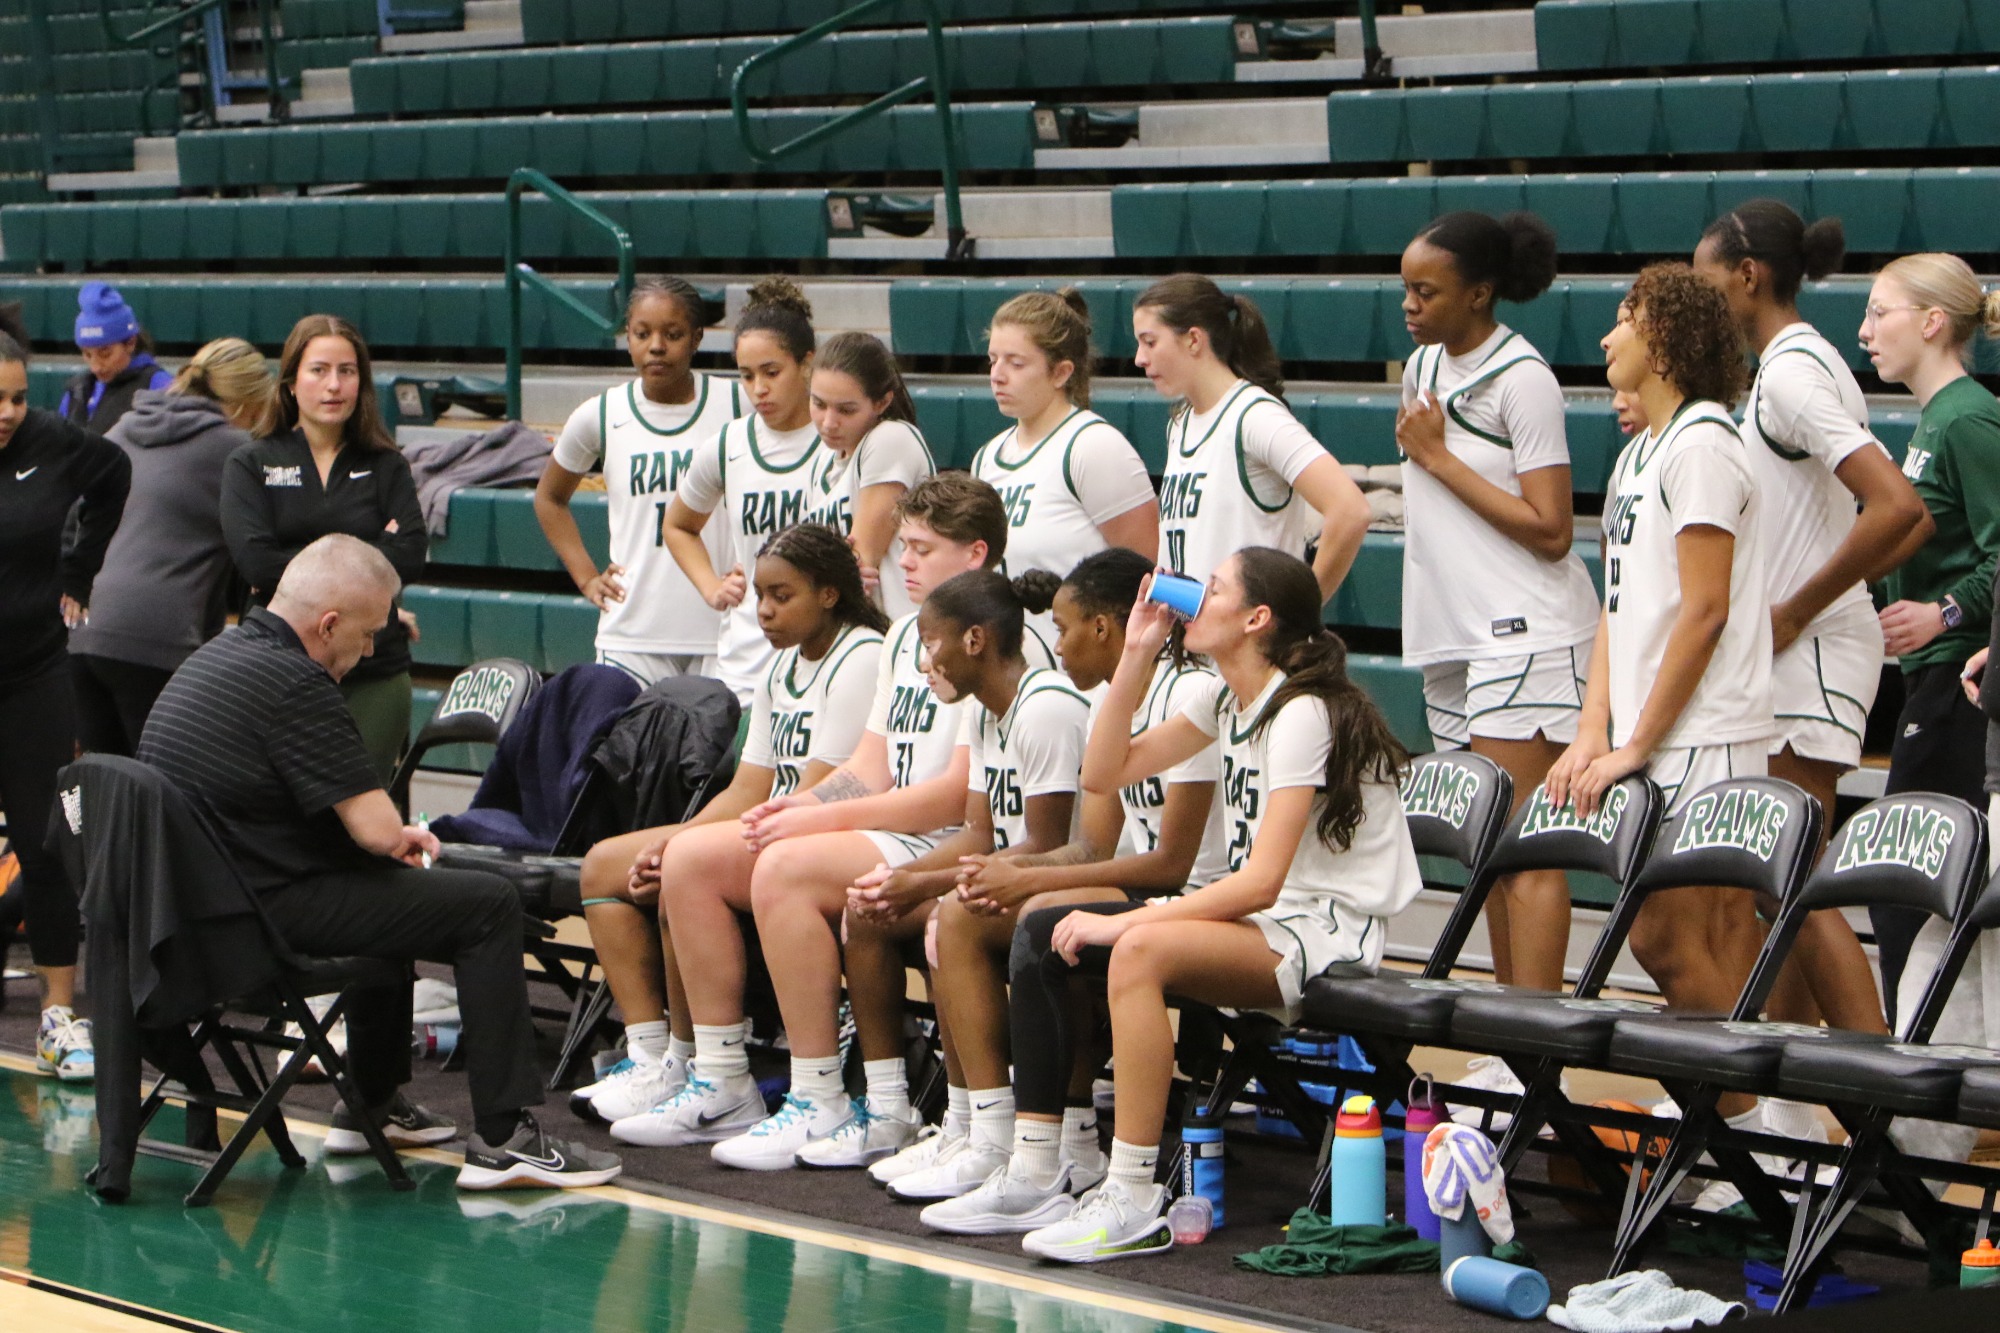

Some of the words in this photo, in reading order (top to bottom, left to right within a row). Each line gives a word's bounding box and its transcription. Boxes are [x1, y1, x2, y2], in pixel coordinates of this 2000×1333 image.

[630, 448, 694, 497] RAM
[742, 489, 808, 536] RAM
[997, 483, 1036, 528] MS
[1608, 494, 1644, 546] AMS
[1513, 620, 1525, 630] XL
[439, 667, 516, 723] RAMS
[1672, 788, 1789, 862] RAMS
[1834, 803, 1956, 880] RAMS
[1182, 1142, 1192, 1197] POWERA
